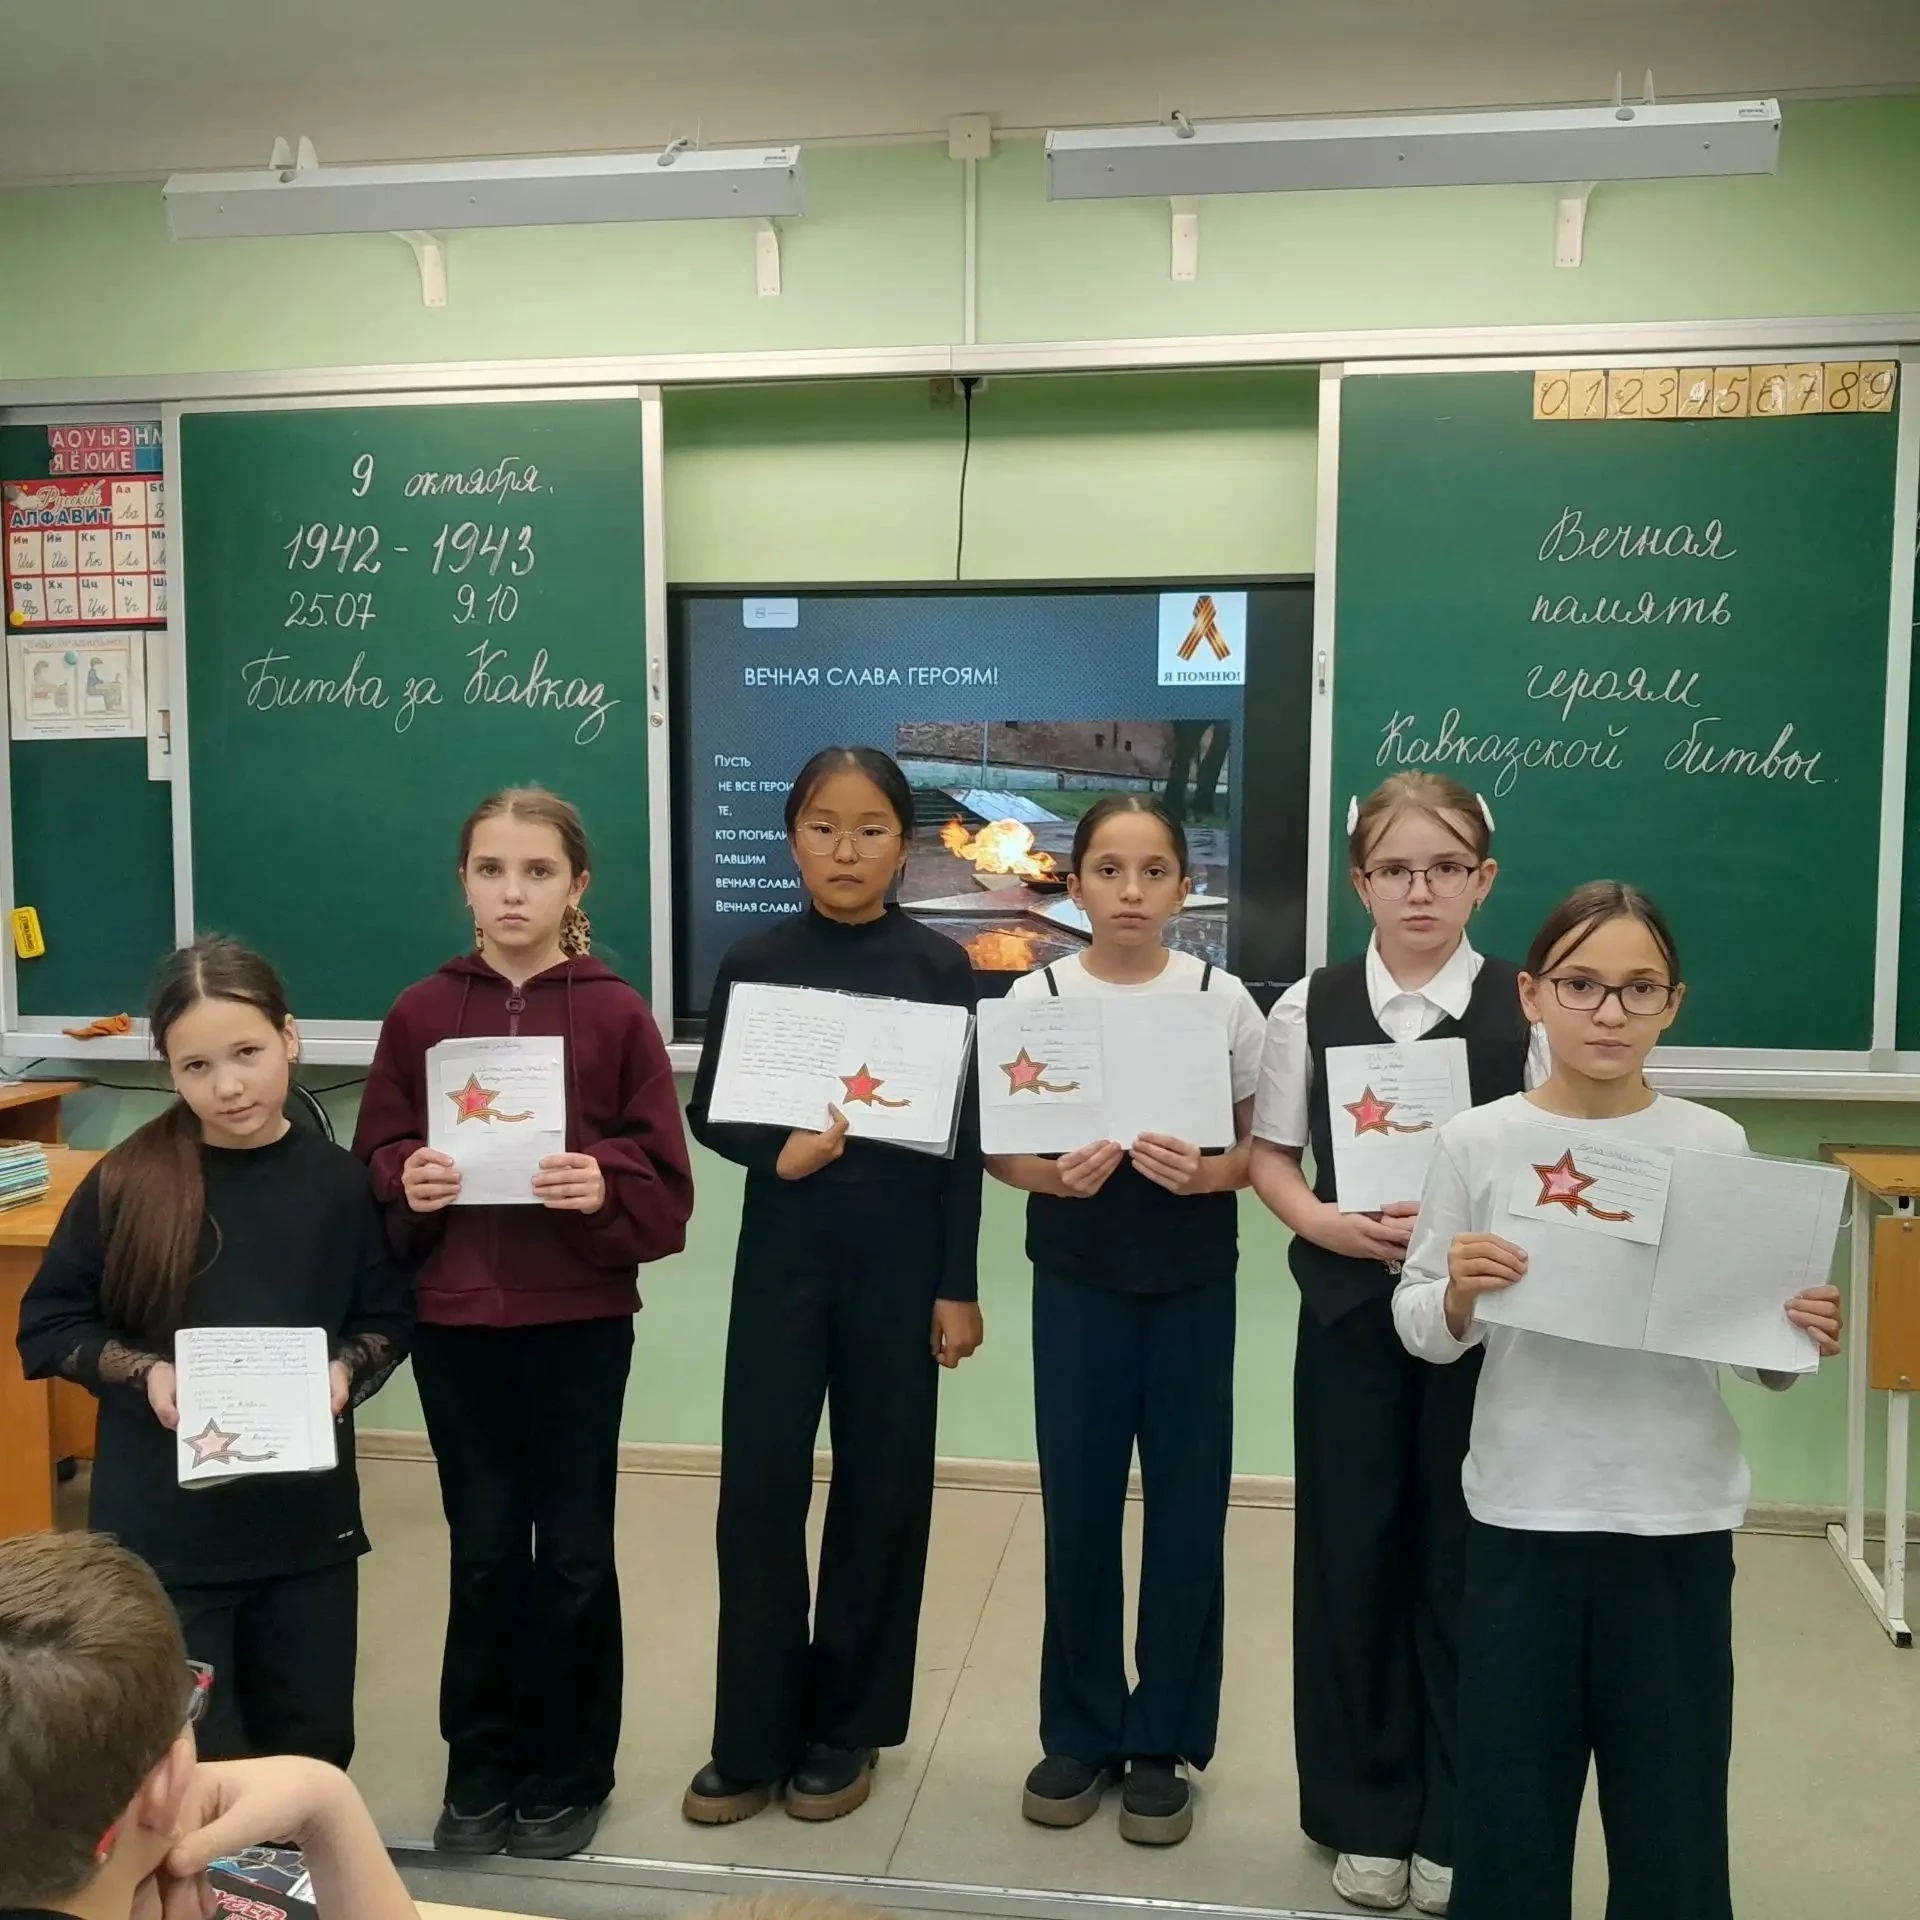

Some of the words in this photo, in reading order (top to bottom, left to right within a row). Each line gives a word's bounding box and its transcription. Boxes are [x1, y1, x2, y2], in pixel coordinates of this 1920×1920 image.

[352, 454, 374, 496] 9
[404, 457, 554, 504] октября.
[11, 508, 112, 527] АЛФАВИТ
[1539, 506, 1737, 561] Вечная
[283, 523, 382, 574] 1942
[432, 522, 535, 576] 1943
[453, 584, 519, 625] 9.10
[1531, 592, 1732, 626] память
[744, 667, 820, 687] ВЕЧНАЯ
[826, 667, 902, 687] СЛАВА
[908, 666, 999, 687] ГЕРОЯМ!
[1164, 671, 1173, 682] Я
[1177, 671, 1241, 682] ПОМНЮ!
[241, 648, 390, 711] Битва
[394, 677, 444, 733] за
[463, 639, 622, 745] Кавказ
[1527, 665, 1702, 721] героям
[1376, 707, 1629, 798] Кавказской
[1664, 717, 1839, 785] битвы.
[718, 781, 733, 792] НЕ
[735, 781, 757, 792] ВСЕ
[716, 830, 736, 841] КТО
[715, 854, 766, 865] ПАВШИМ
[716, 878, 757, 889] ВЕЧНАЯ
[758, 878, 800, 890] СЛАВА!
[759, 902, 802, 914] СЛАВА!
